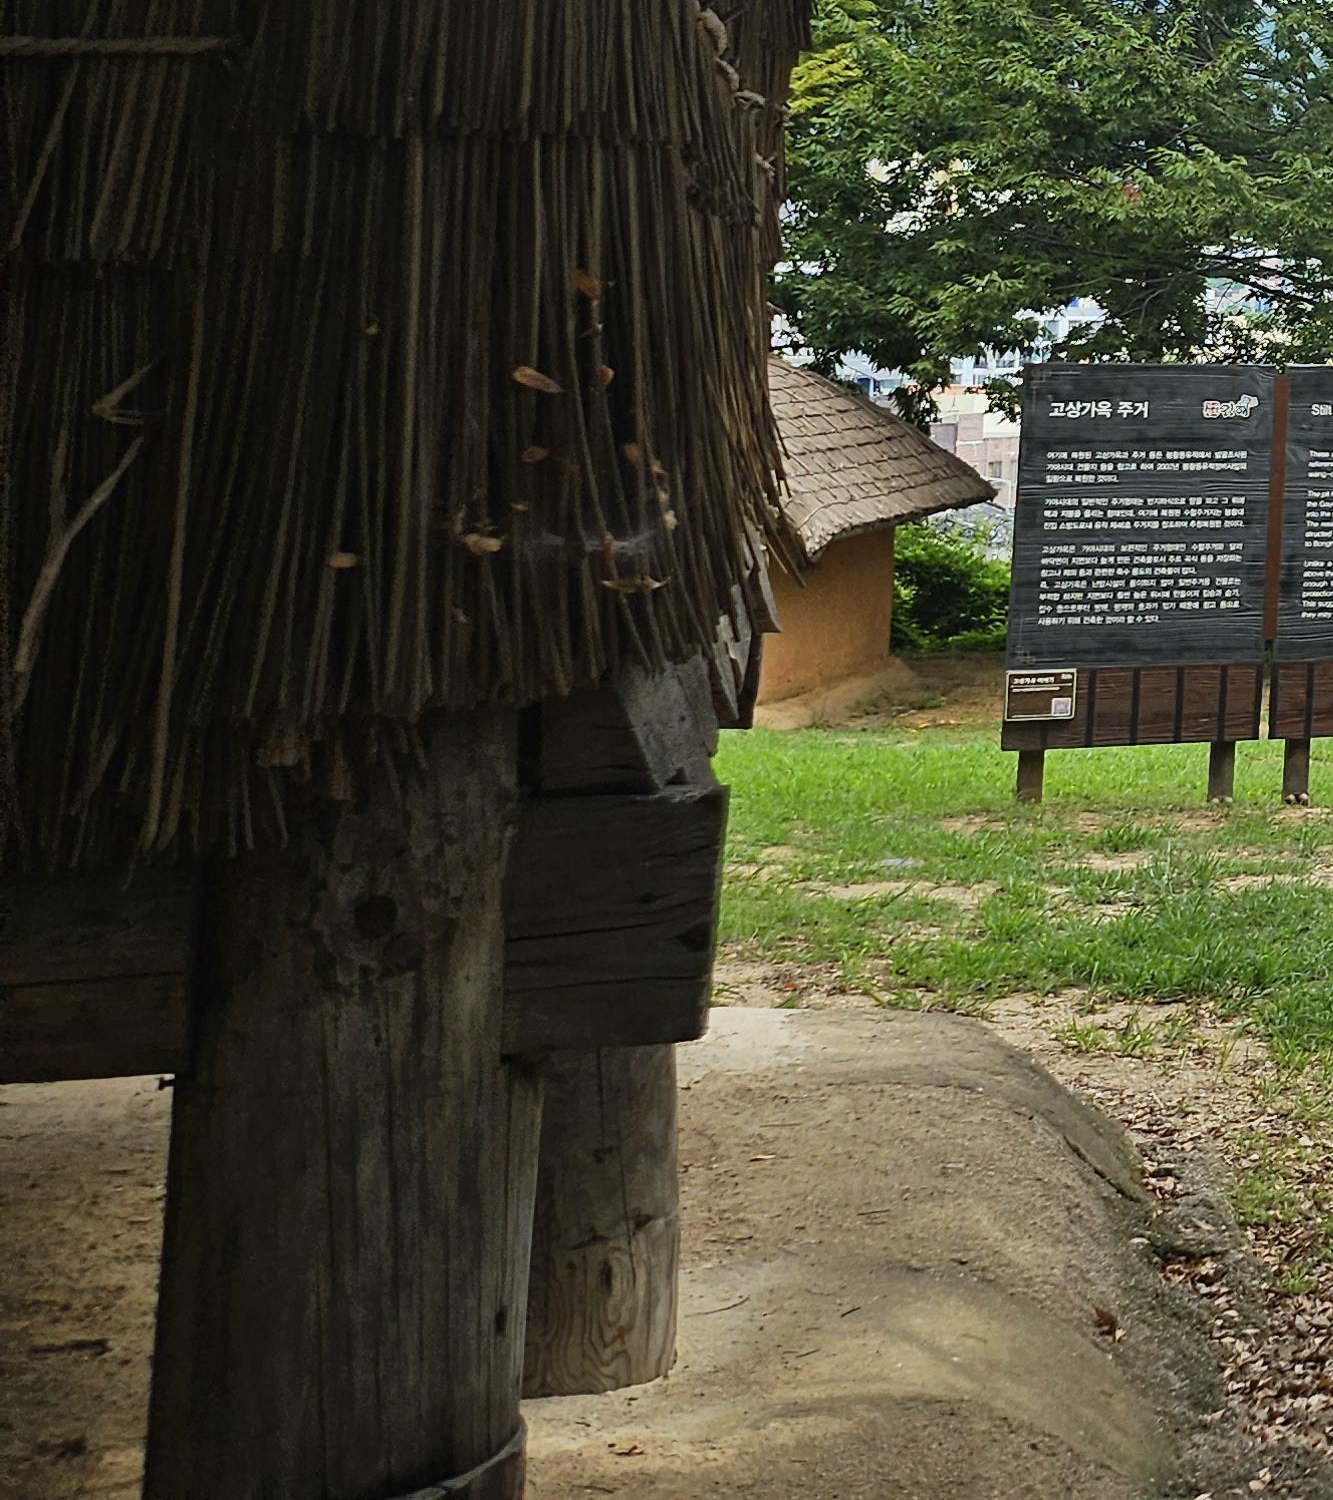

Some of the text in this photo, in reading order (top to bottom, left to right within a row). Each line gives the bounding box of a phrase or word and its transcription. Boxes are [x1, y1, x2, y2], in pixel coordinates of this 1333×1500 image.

[1048, 401, 1149, 418] 고상가옥 주거
[1310, 403, 1332, 415] Stilt
